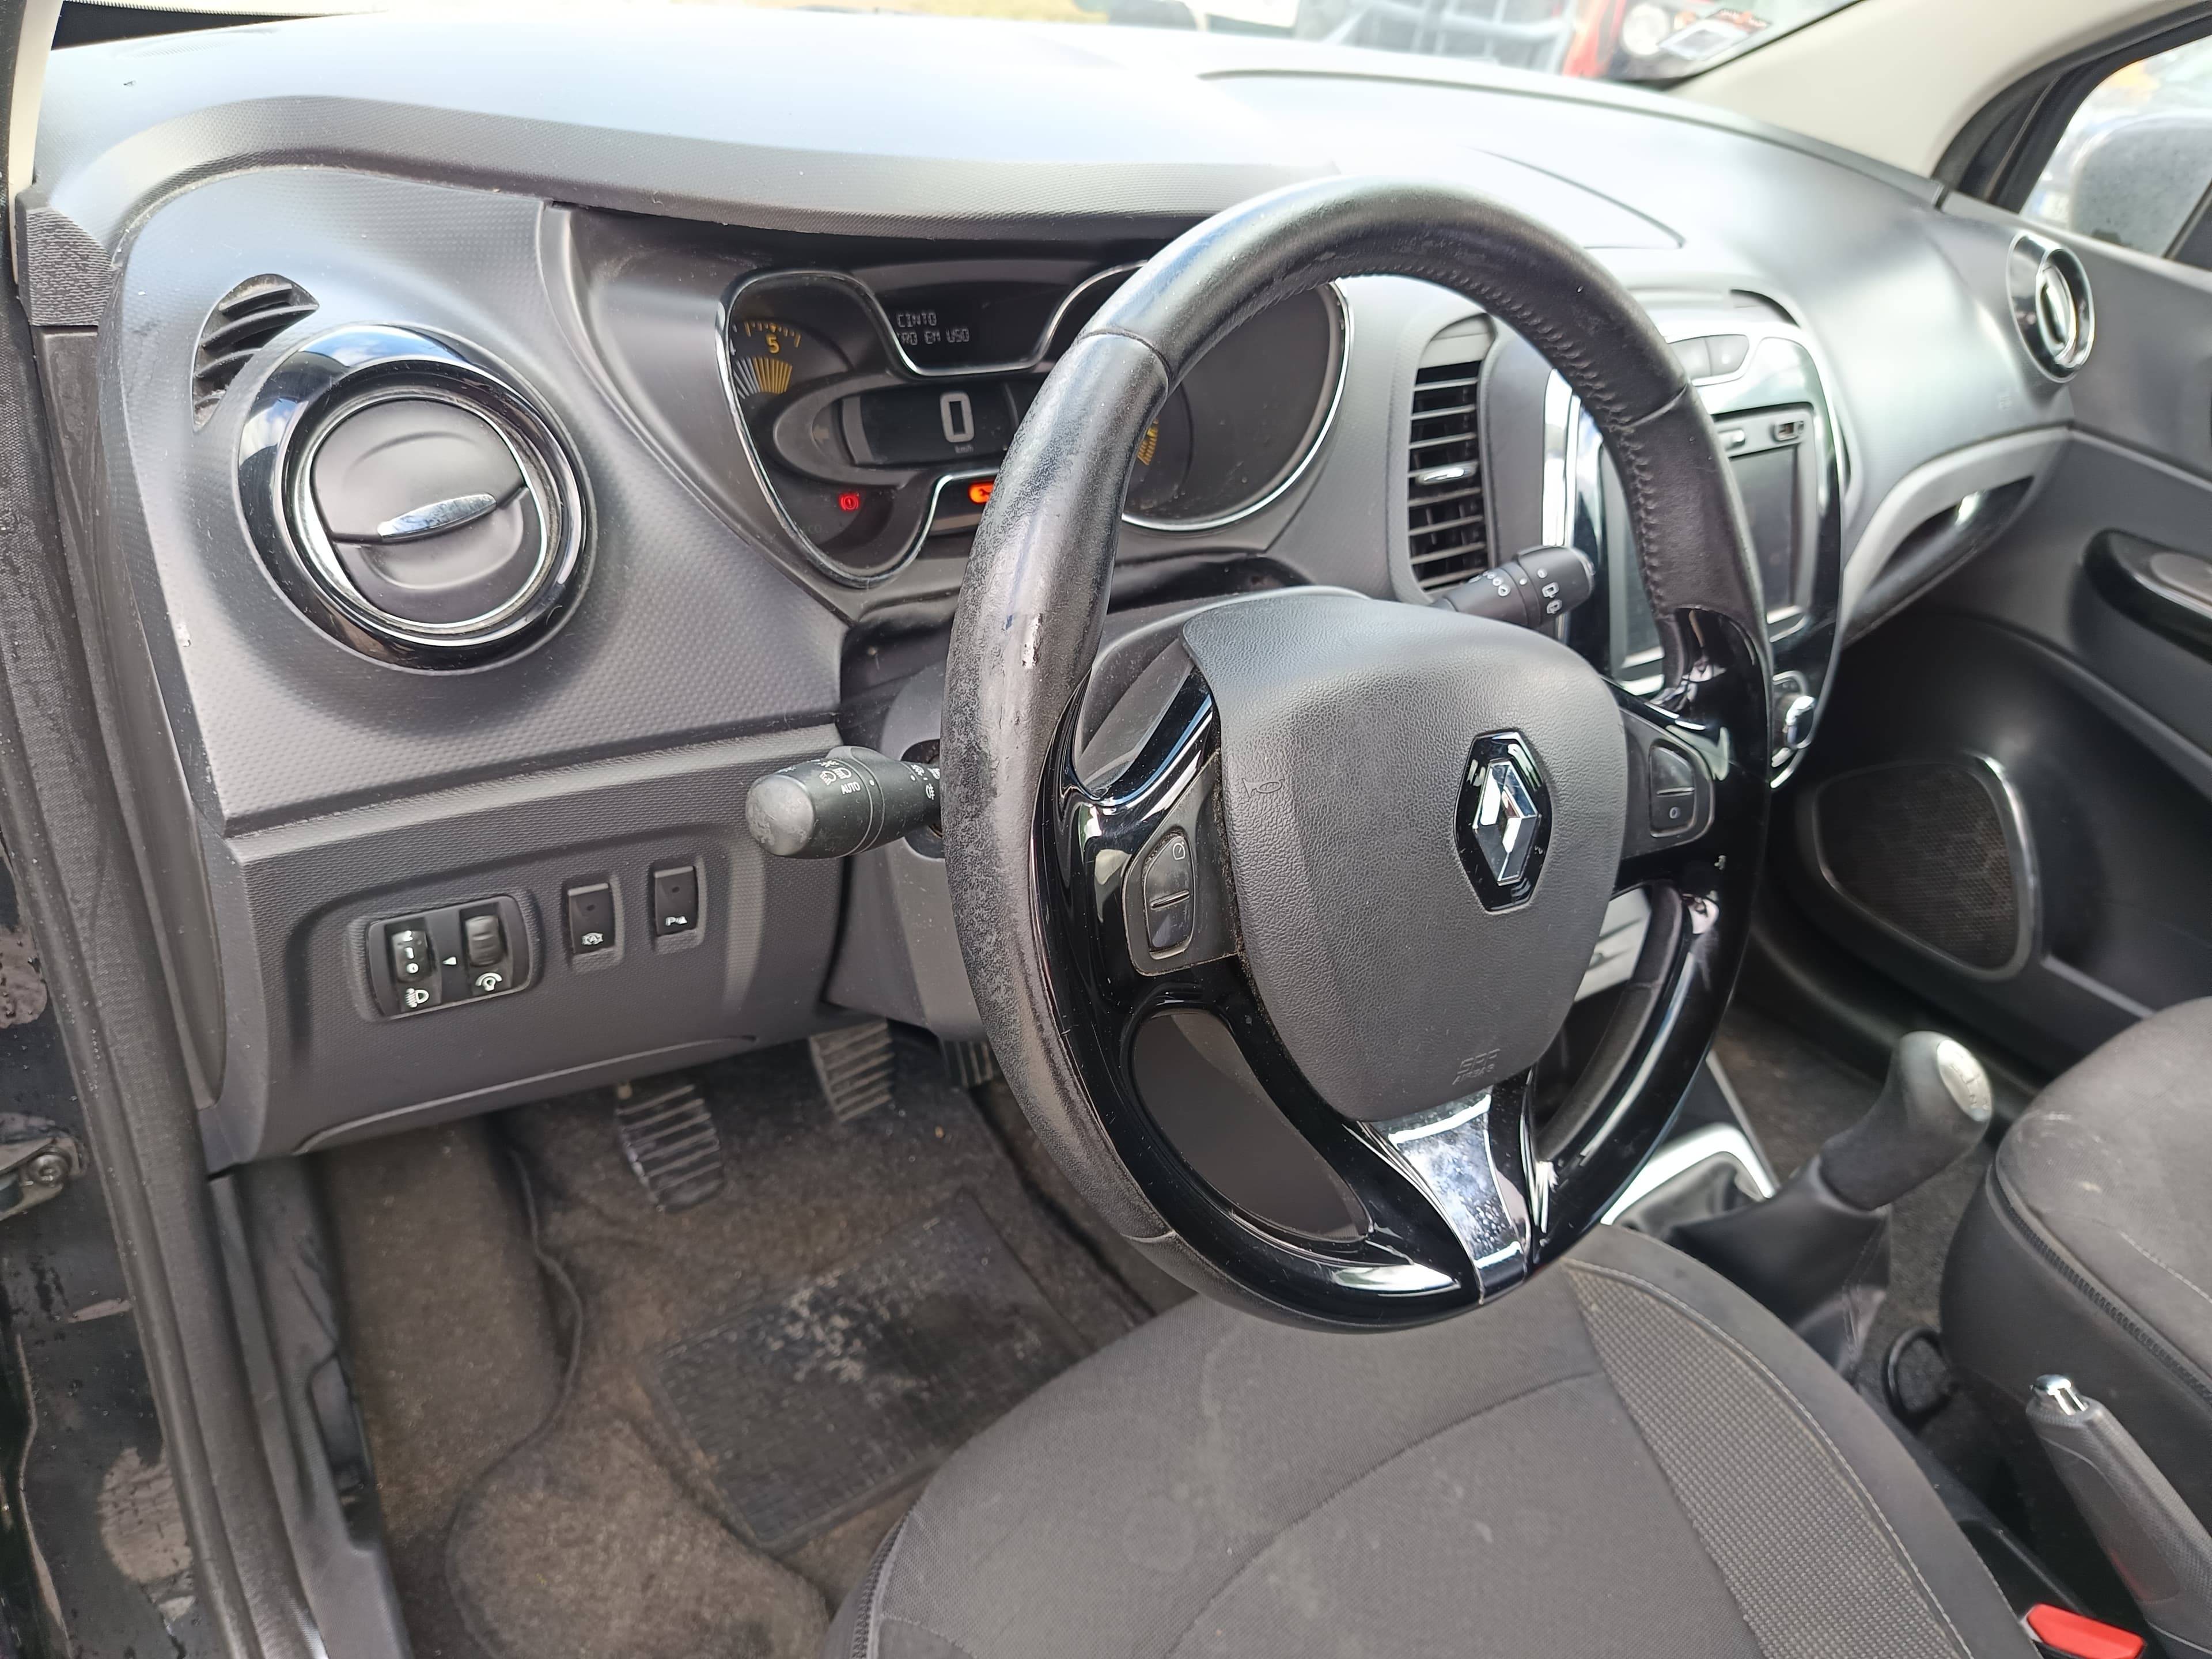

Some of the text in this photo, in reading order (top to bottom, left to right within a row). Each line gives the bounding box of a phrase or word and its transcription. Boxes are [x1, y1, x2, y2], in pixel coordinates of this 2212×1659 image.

[897, 313, 937, 328] CINTO
[946, 328, 970, 343] USO
[766, 335, 779, 354] 5
[940, 392, 975, 443] 0
[840, 781, 861, 794] AUTO
